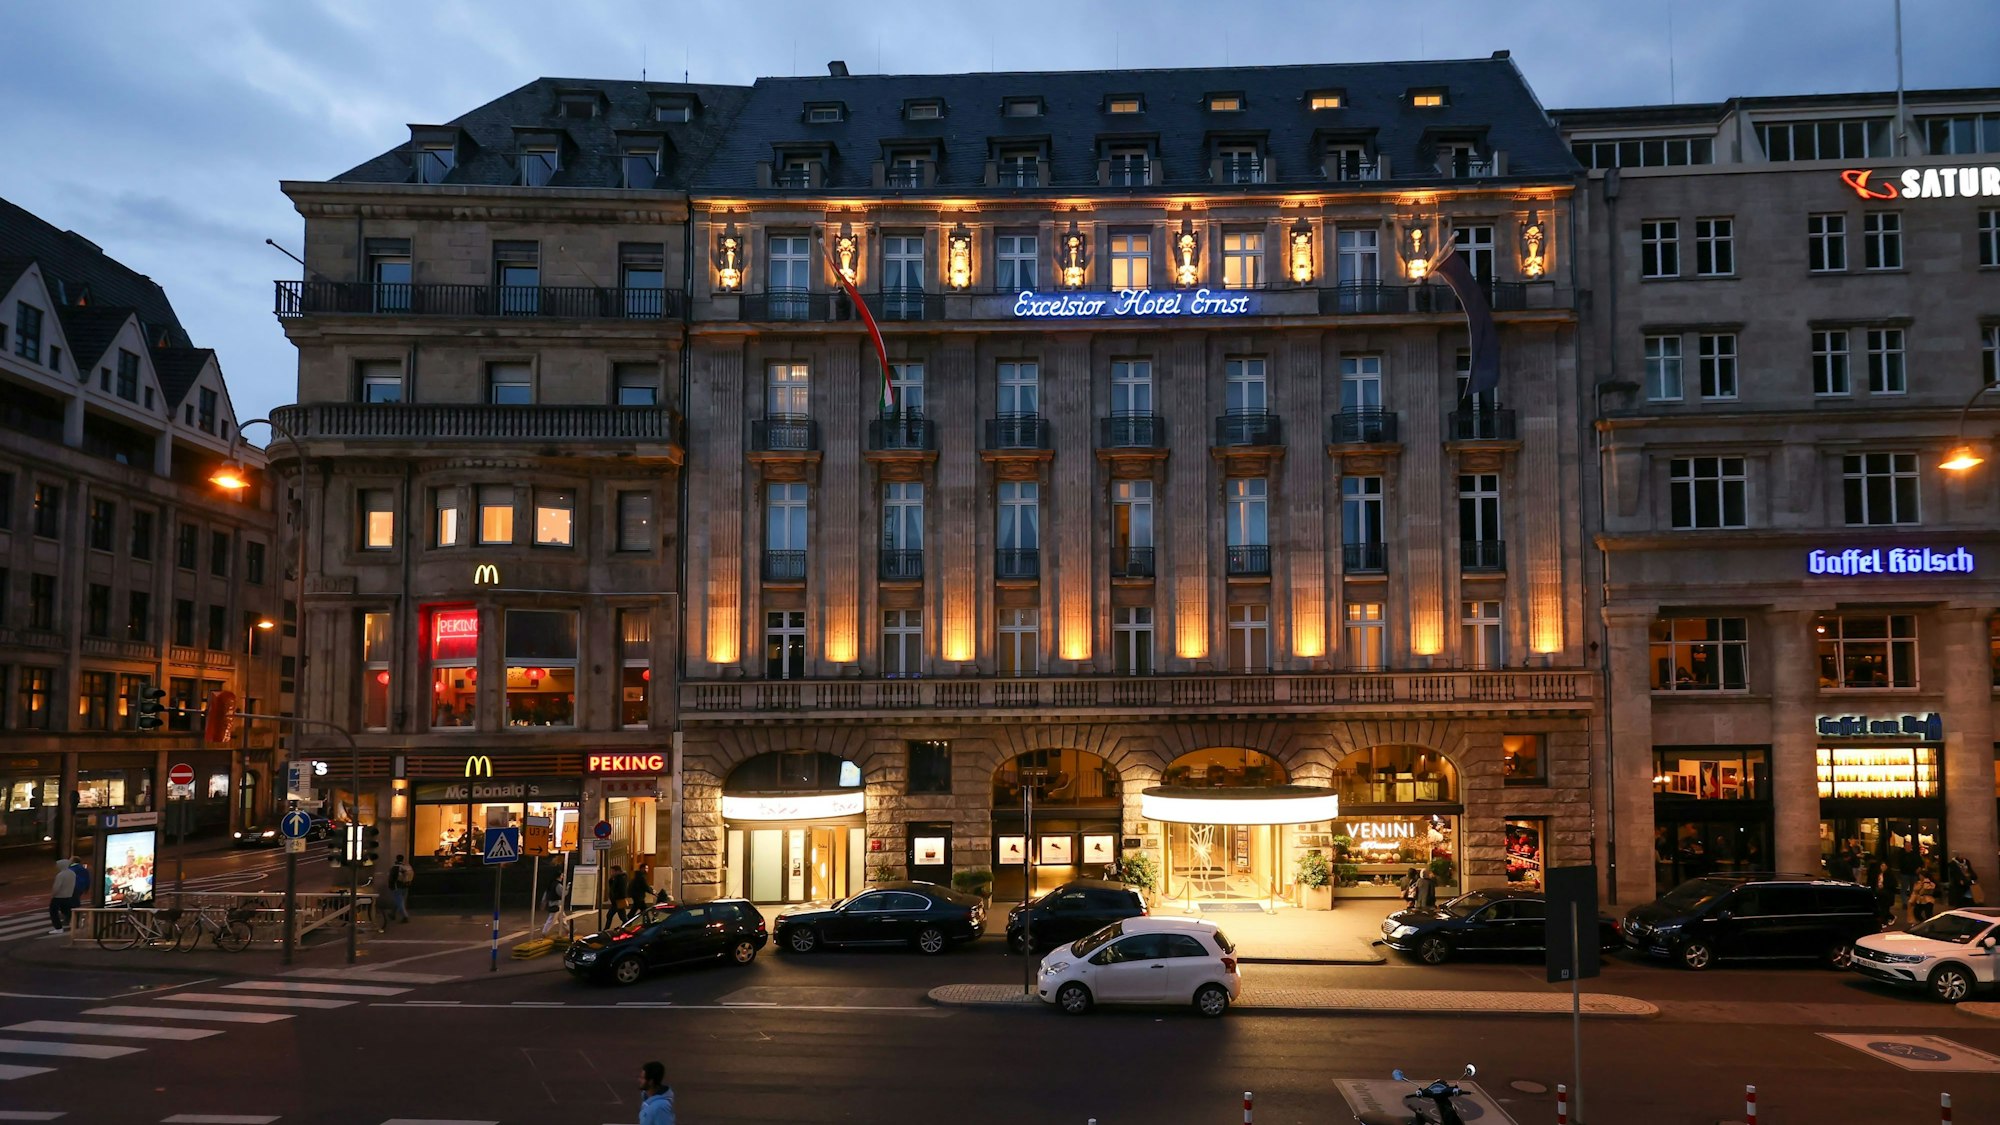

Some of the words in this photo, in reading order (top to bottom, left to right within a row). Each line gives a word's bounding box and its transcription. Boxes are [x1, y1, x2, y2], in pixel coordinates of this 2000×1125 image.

[1014, 290, 1105, 317] Excelsior
[1114, 289, 1182, 316] Hotel
[1191, 288, 1249, 315] Ernst
[1809, 549, 1884, 575] Gaffel
[1889, 547, 1974, 573] Kölsch
[589, 755, 664, 771] PEKING
[1346, 822, 1415, 839] VENINI
